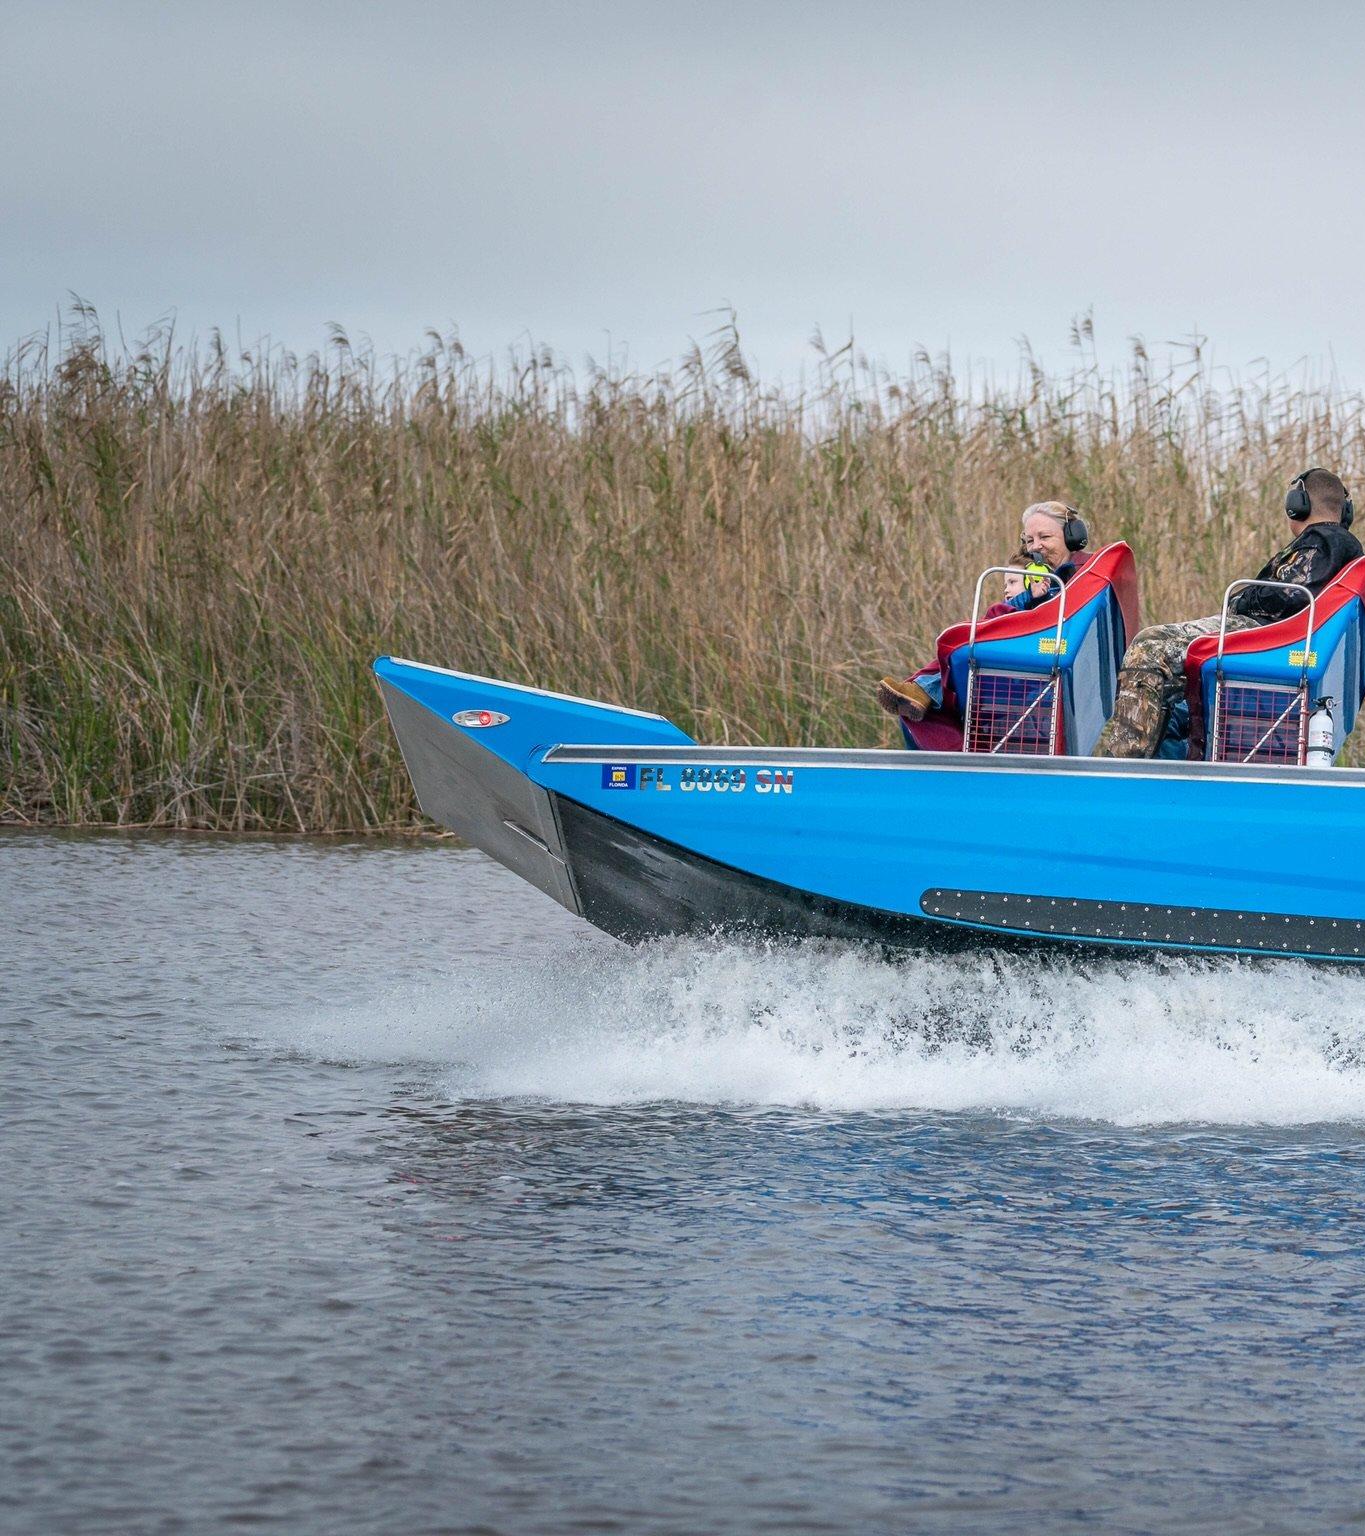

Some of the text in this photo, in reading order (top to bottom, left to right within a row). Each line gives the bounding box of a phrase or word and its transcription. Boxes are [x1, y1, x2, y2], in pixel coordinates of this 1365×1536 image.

[639, 767, 794, 794] FL 8869 SN
